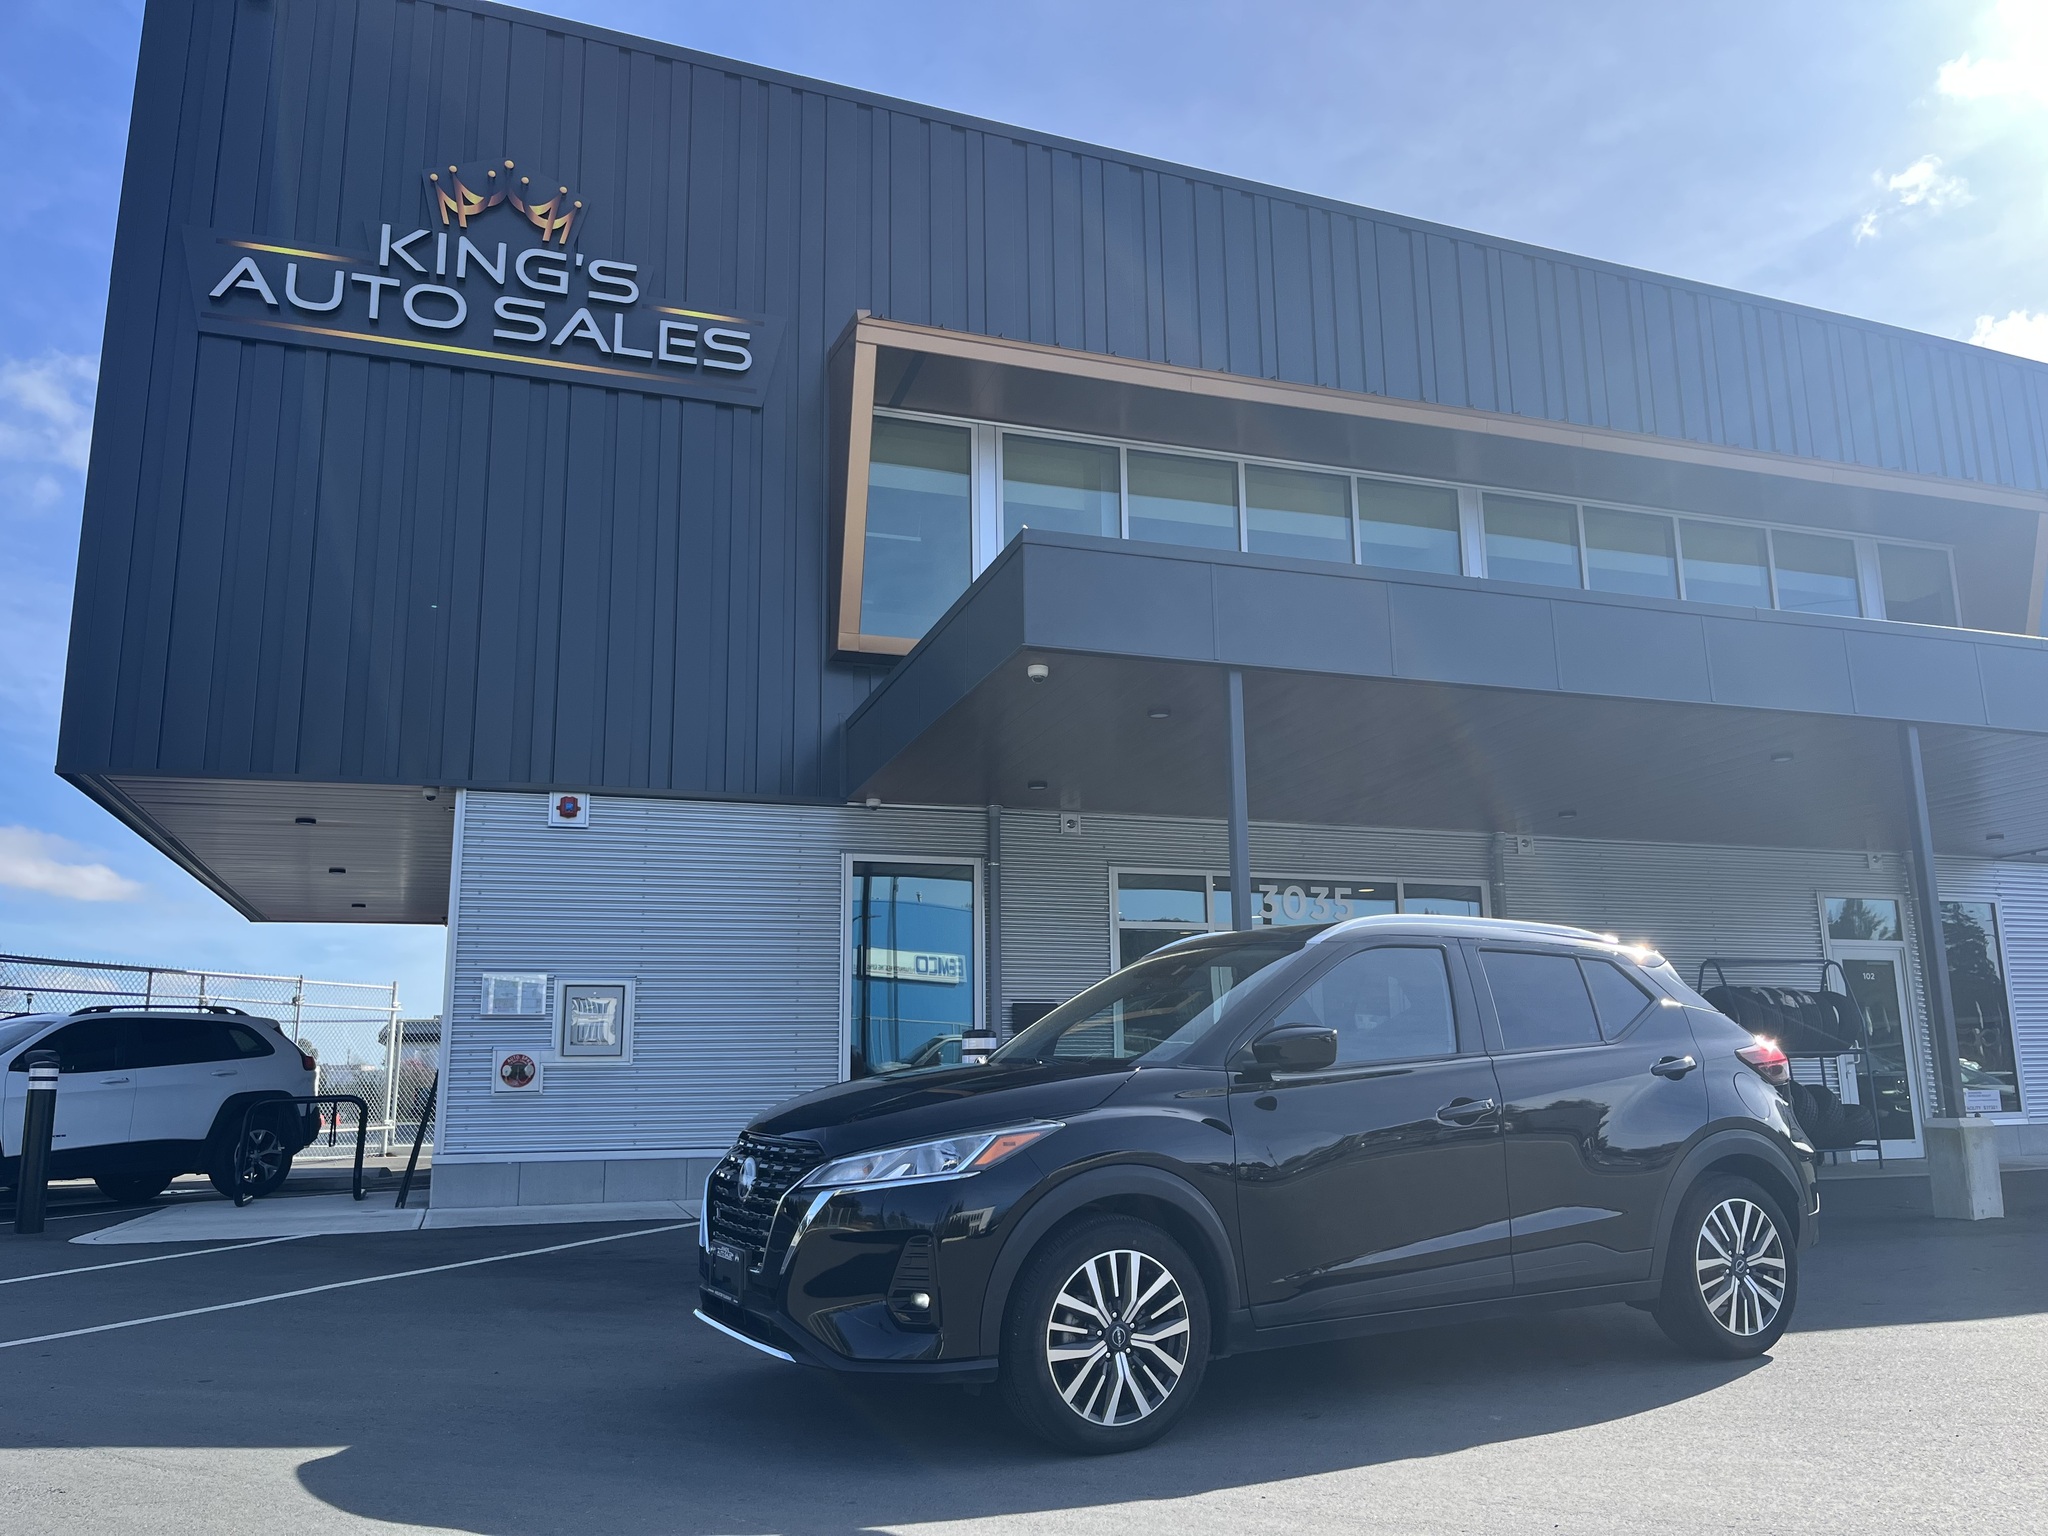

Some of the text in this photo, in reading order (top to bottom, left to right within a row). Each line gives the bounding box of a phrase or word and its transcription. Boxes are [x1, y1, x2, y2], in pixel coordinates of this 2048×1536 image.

[379, 222, 640, 304] KING'S
[208, 255, 753, 372] AUTO SALES
[1258, 884, 1354, 921] 3035
[1862, 972, 1876, 980] 102
